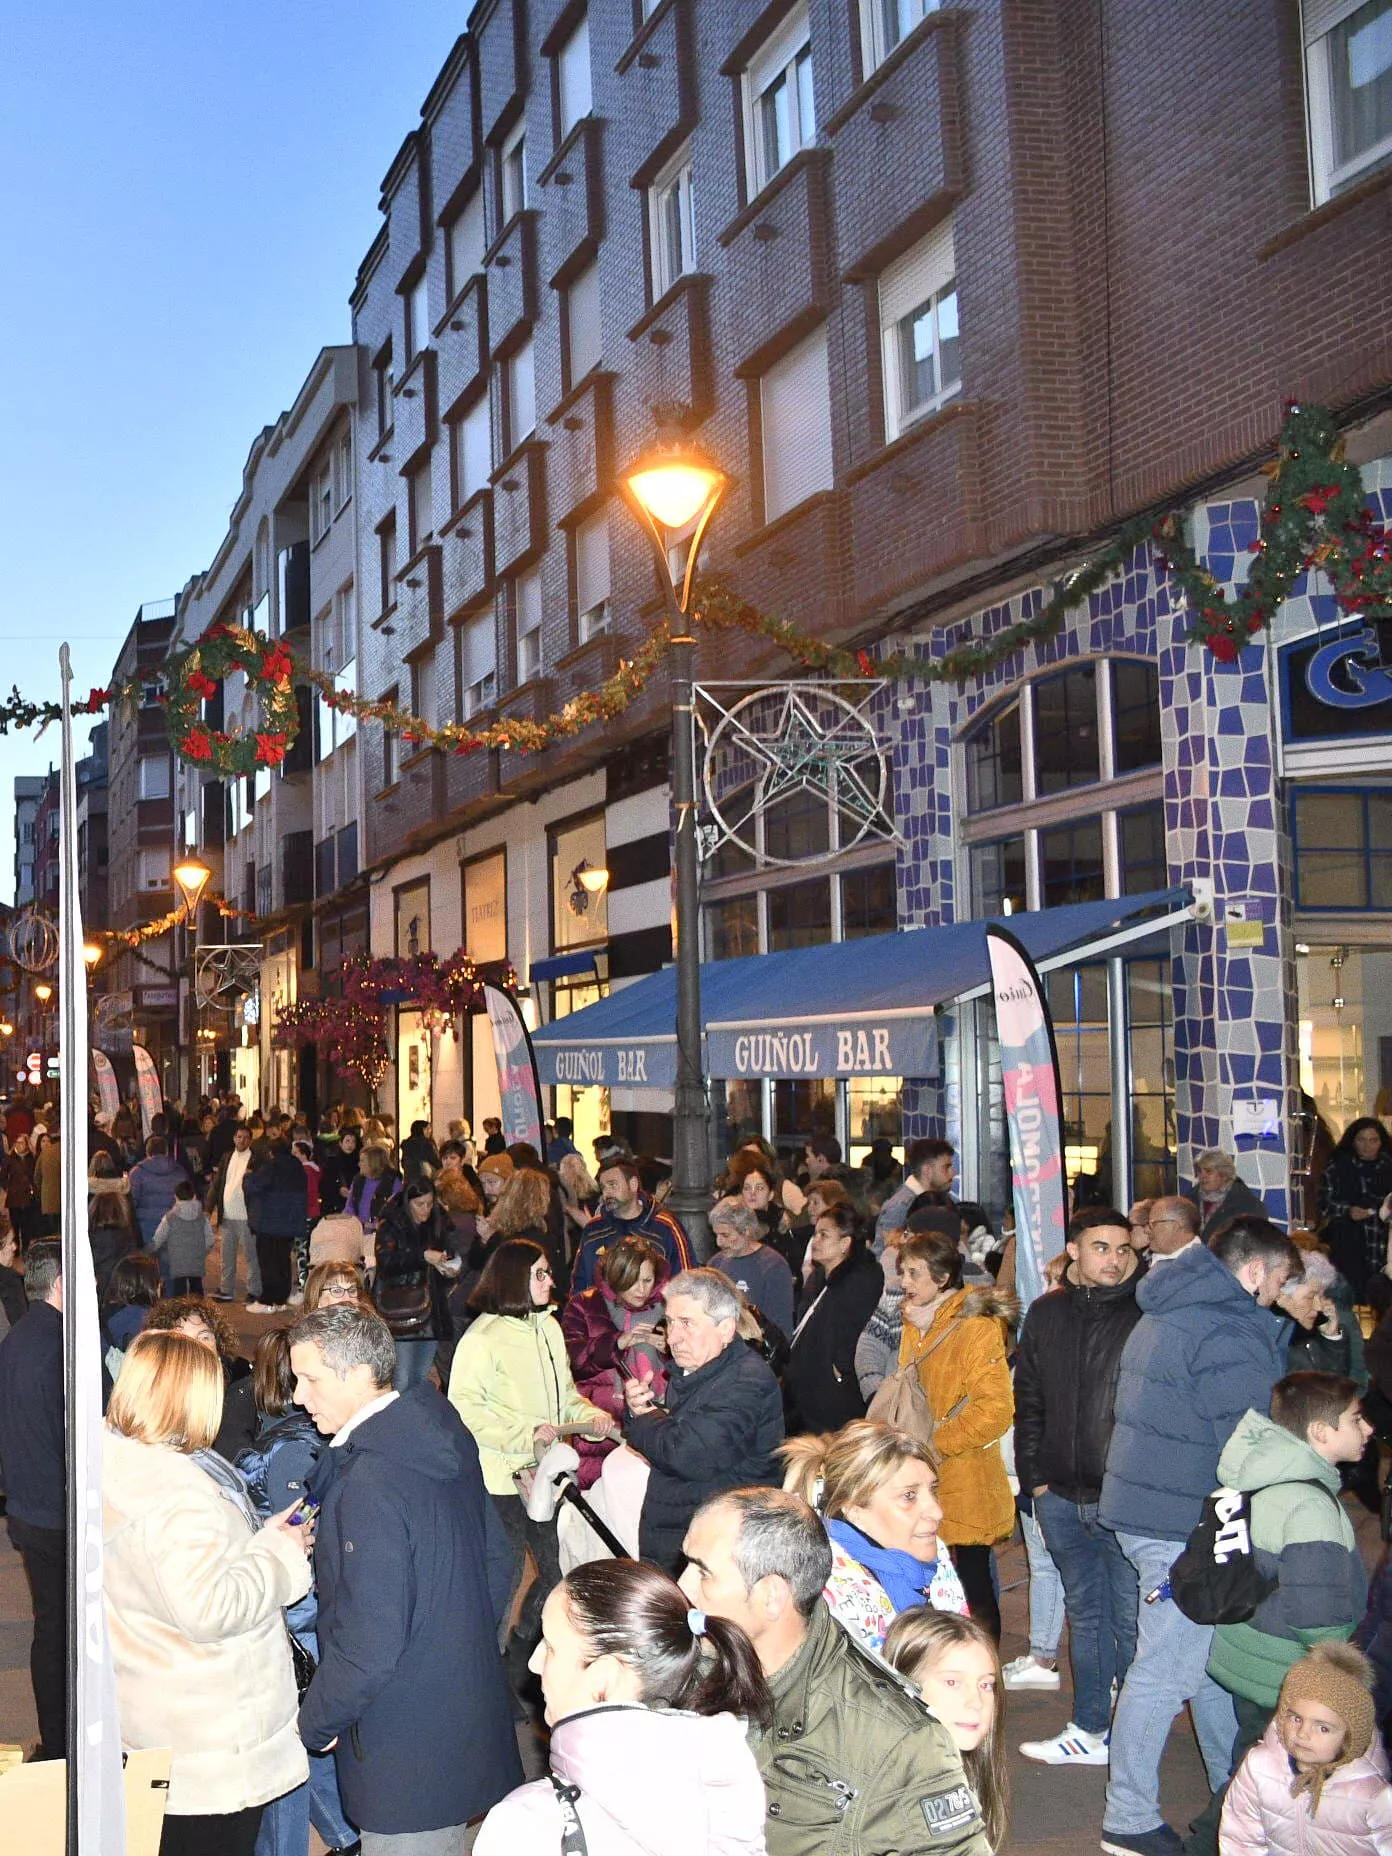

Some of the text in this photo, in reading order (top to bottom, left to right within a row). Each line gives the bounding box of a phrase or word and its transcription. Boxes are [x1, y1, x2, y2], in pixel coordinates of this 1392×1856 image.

[555, 1048, 648, 1082] GUIÑOL BAR
[735, 1028, 893, 1073] GUIÑOL BAR
